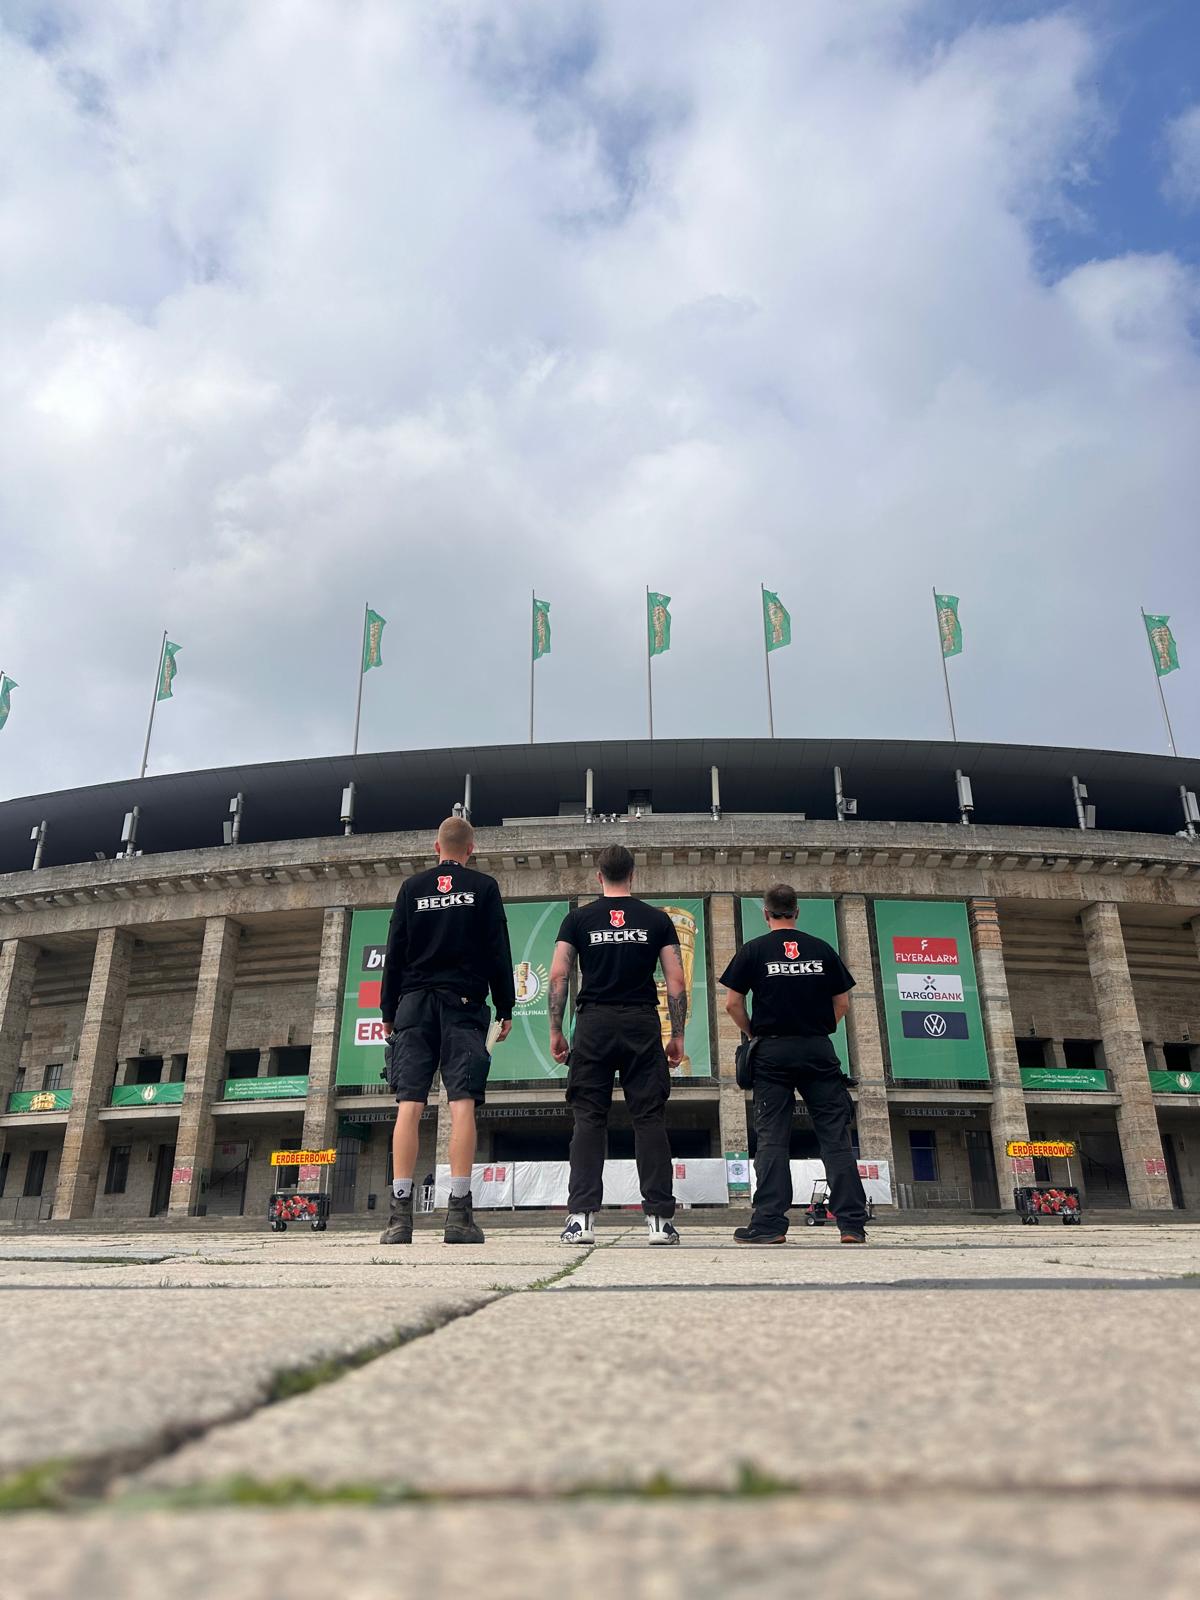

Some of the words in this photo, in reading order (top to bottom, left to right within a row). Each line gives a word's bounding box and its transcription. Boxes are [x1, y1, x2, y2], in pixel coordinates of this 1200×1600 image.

[416, 893, 475, 911] BECK'S
[590, 928, 648, 944] BECK'S
[895, 952, 958, 963] FLYERALARM
[767, 960, 824, 975] BECK'S
[900, 991, 962, 1001] TARGOBANK
[357, 1022, 385, 1040] ER
[1012, 1145, 1074, 1155] ERDBEERBOWLE
[275, 1153, 336, 1164] ERDBEERBOWLE
